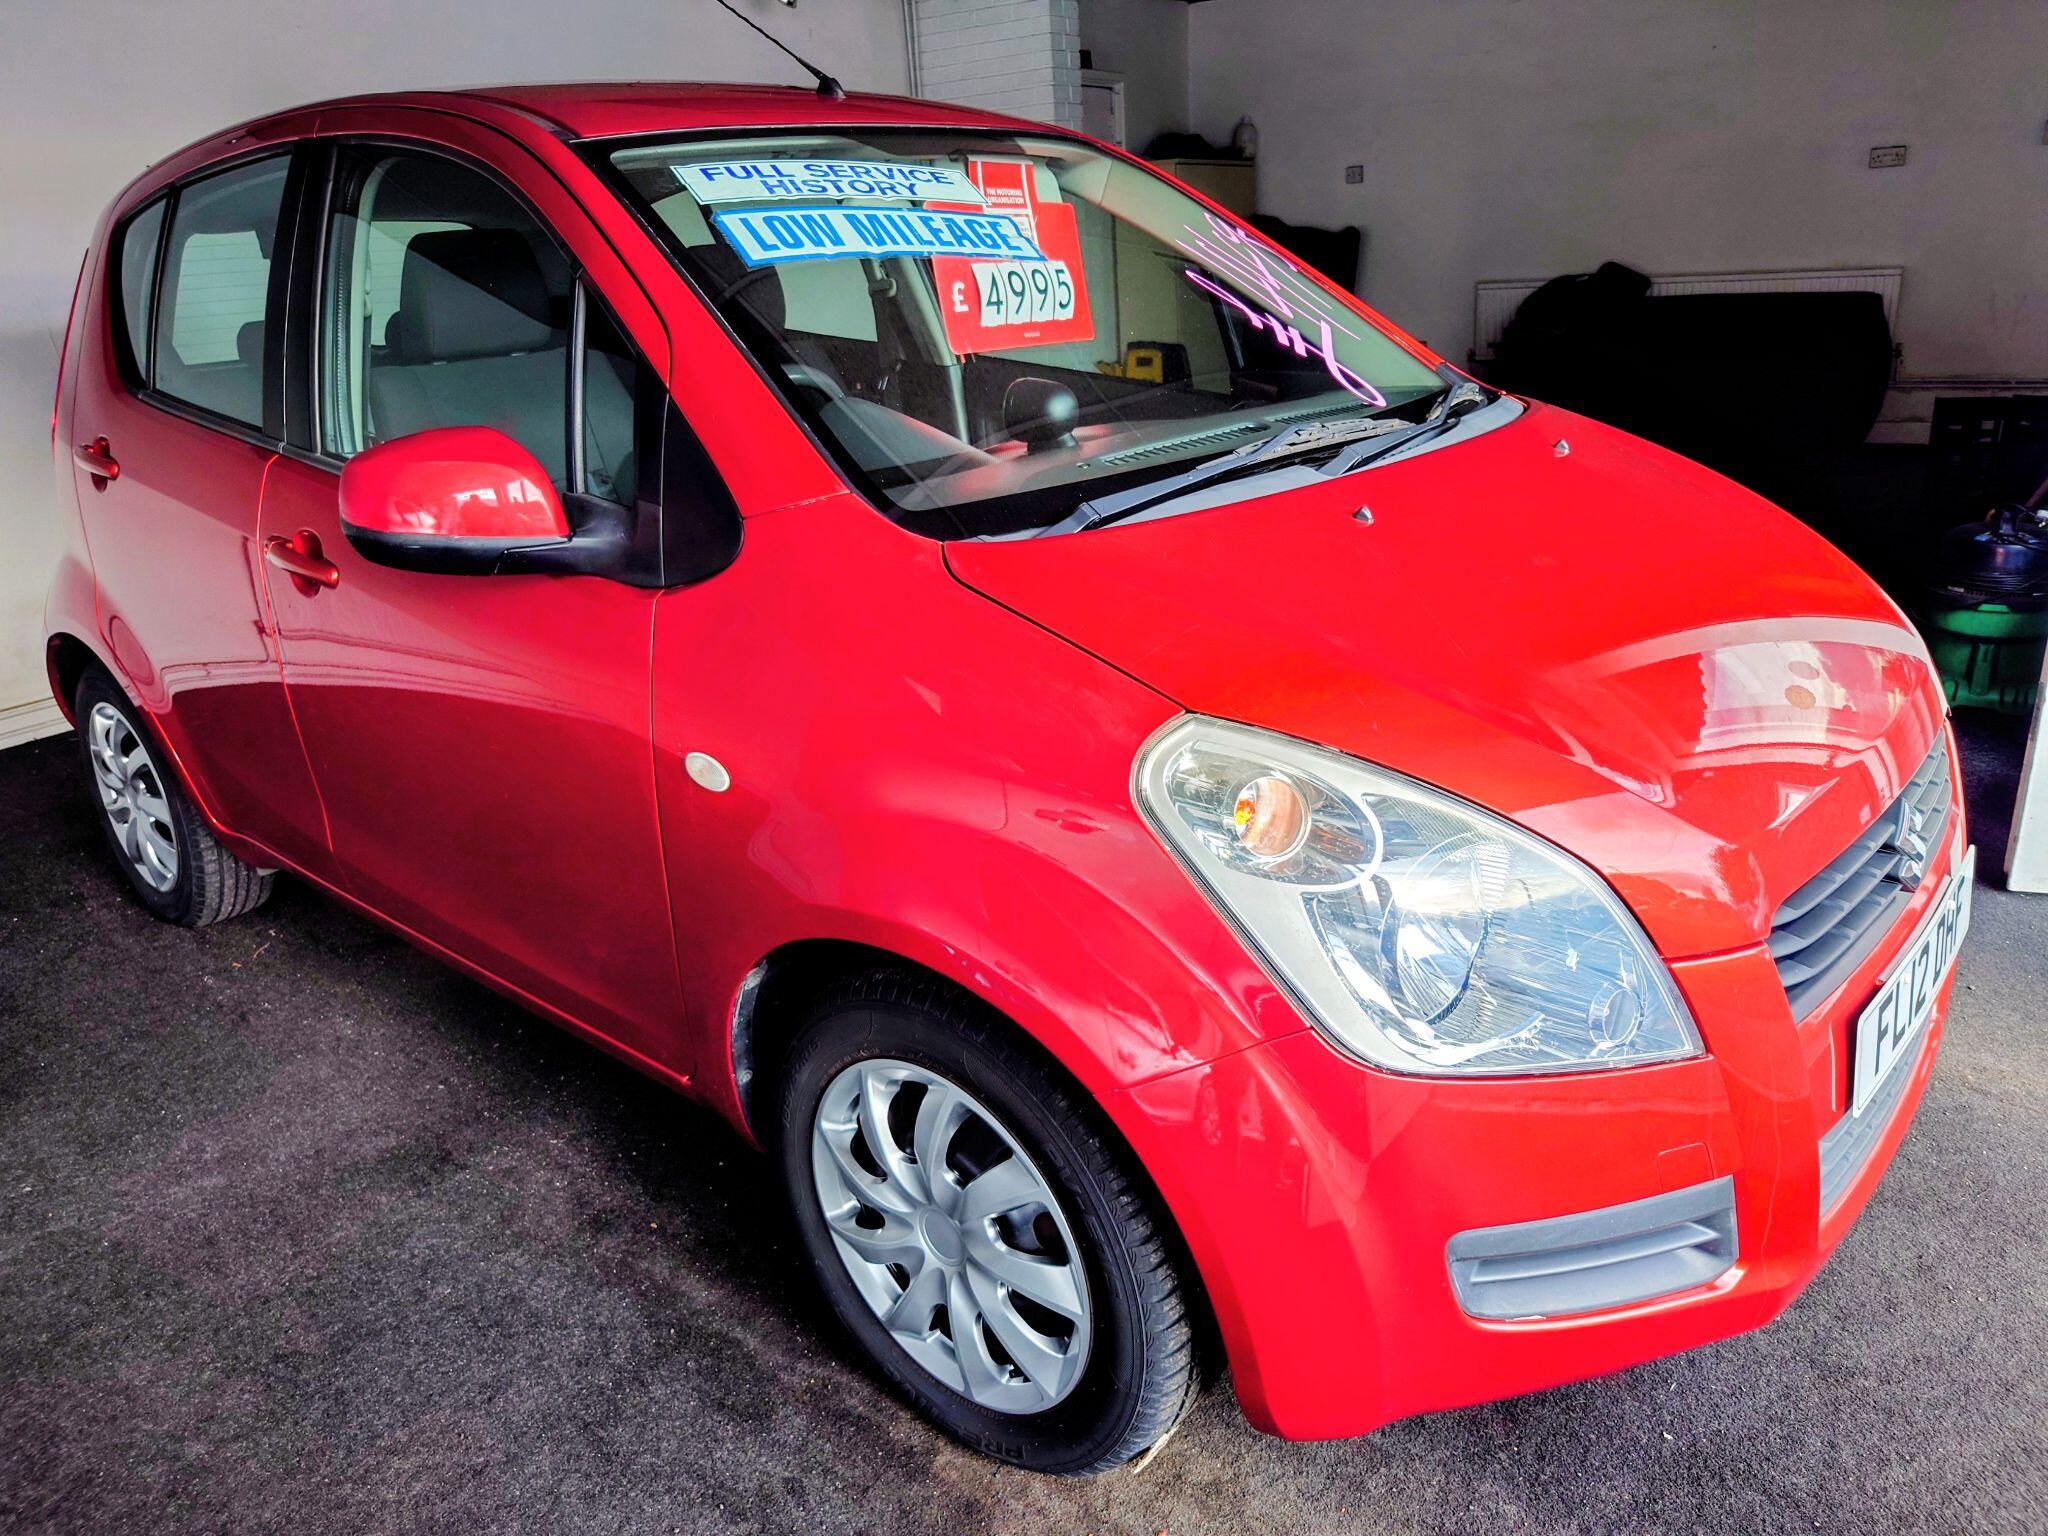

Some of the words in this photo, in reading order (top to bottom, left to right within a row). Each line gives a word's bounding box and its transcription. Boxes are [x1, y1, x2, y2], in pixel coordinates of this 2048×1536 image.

[699, 164, 798, 181] FULL
[803, 163, 954, 185] SERVICE
[760, 179, 921, 196] HISTORY
[739, 213, 846, 252] LOW
[842, 213, 1024, 252] MILEAGE
[985, 268, 1072, 315] 4995
[1874, 940, 1930, 1077] FL12
